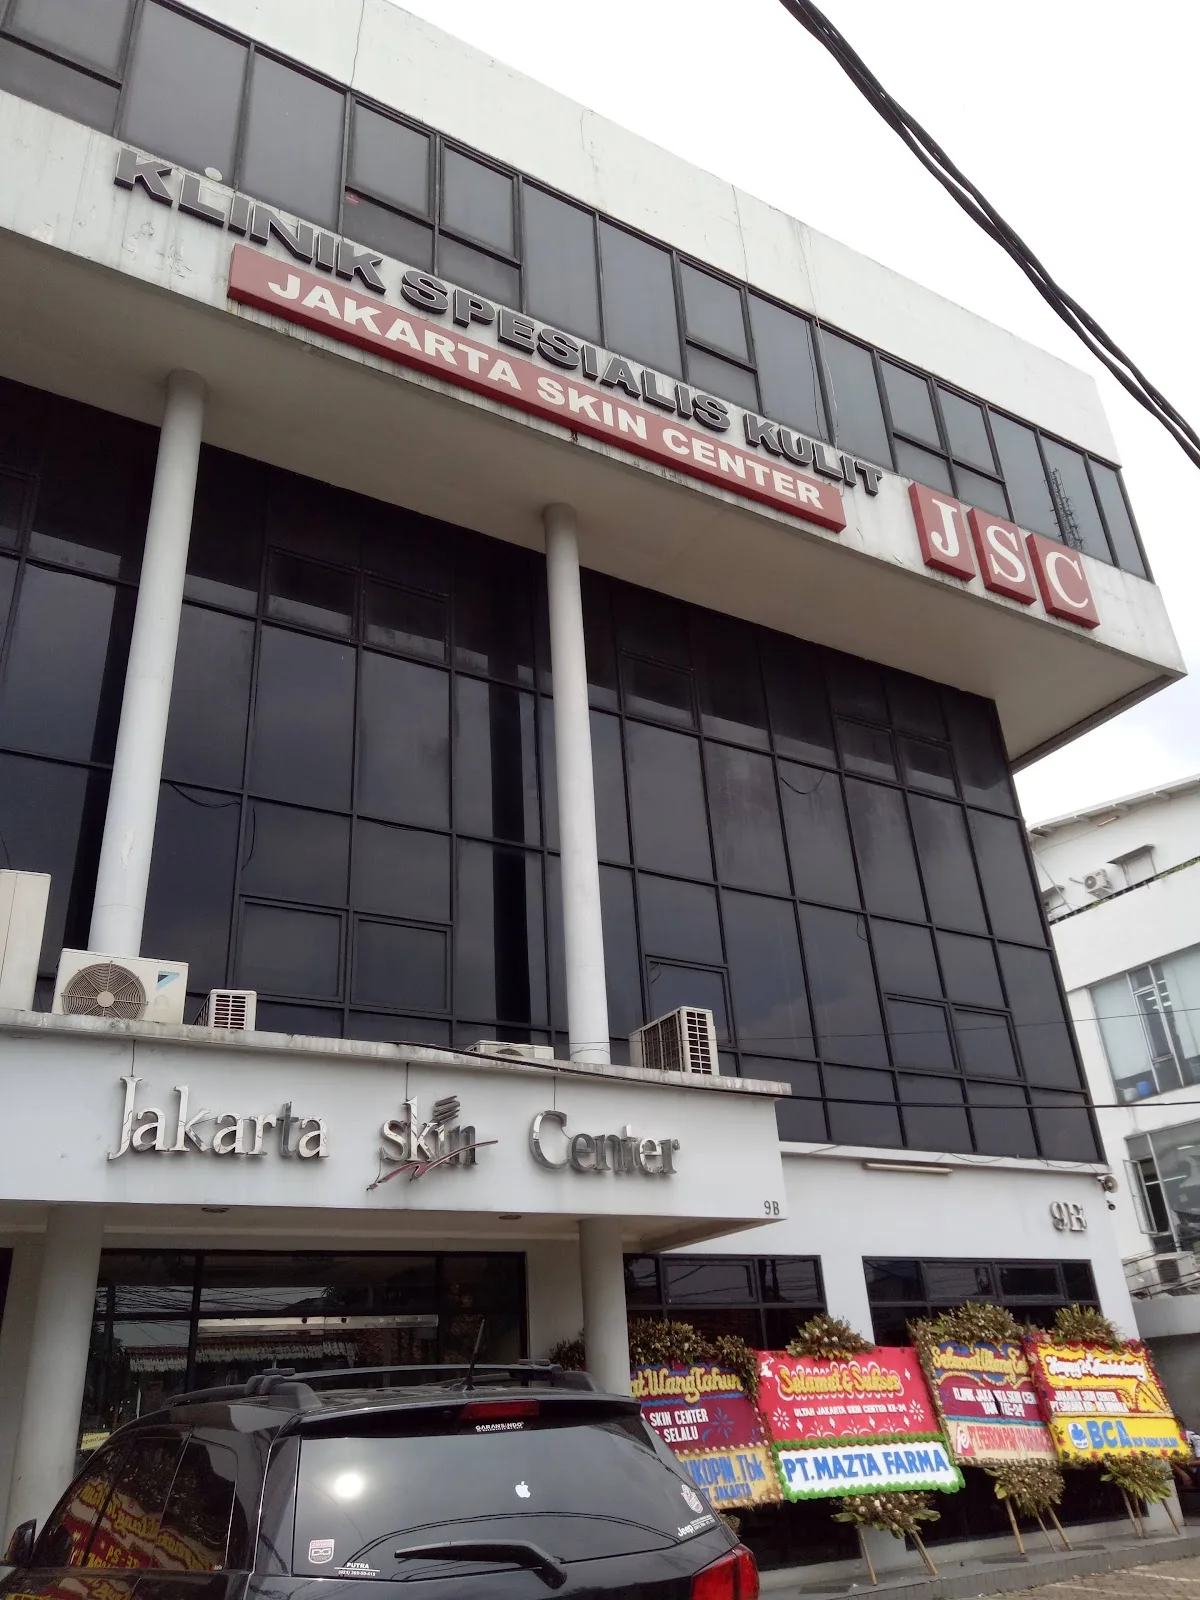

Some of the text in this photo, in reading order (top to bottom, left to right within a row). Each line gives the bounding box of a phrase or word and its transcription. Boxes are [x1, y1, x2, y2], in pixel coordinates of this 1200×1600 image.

[114, 147, 883, 497] KLINIK SPESIALIS KULIT
[267, 273, 824, 510] JAKARTA SKIN CENTER
[107, 1075, 681, 1176] Jakarta skin Center
[764, 1200, 780, 1216] 9B
[1050, 1201, 1087, 1232] 9B
[690, 1366, 744, 1393] Tahun
[779, 1367, 842, 1394] Selamat
[850, 1366, 901, 1392] Sukses
[650, 1408, 709, 1427] SKIN CENTER
[794, 1403, 908, 1418] ULTAH JAKARTA SKIN CENTER KE-24
[664, 1425, 699, 1443] SELALU
[1086, 1420, 1133, 1449] BCA
[882, 1449, 949, 1475] FARMA
[678, 1524, 694, 1537] Jeep
